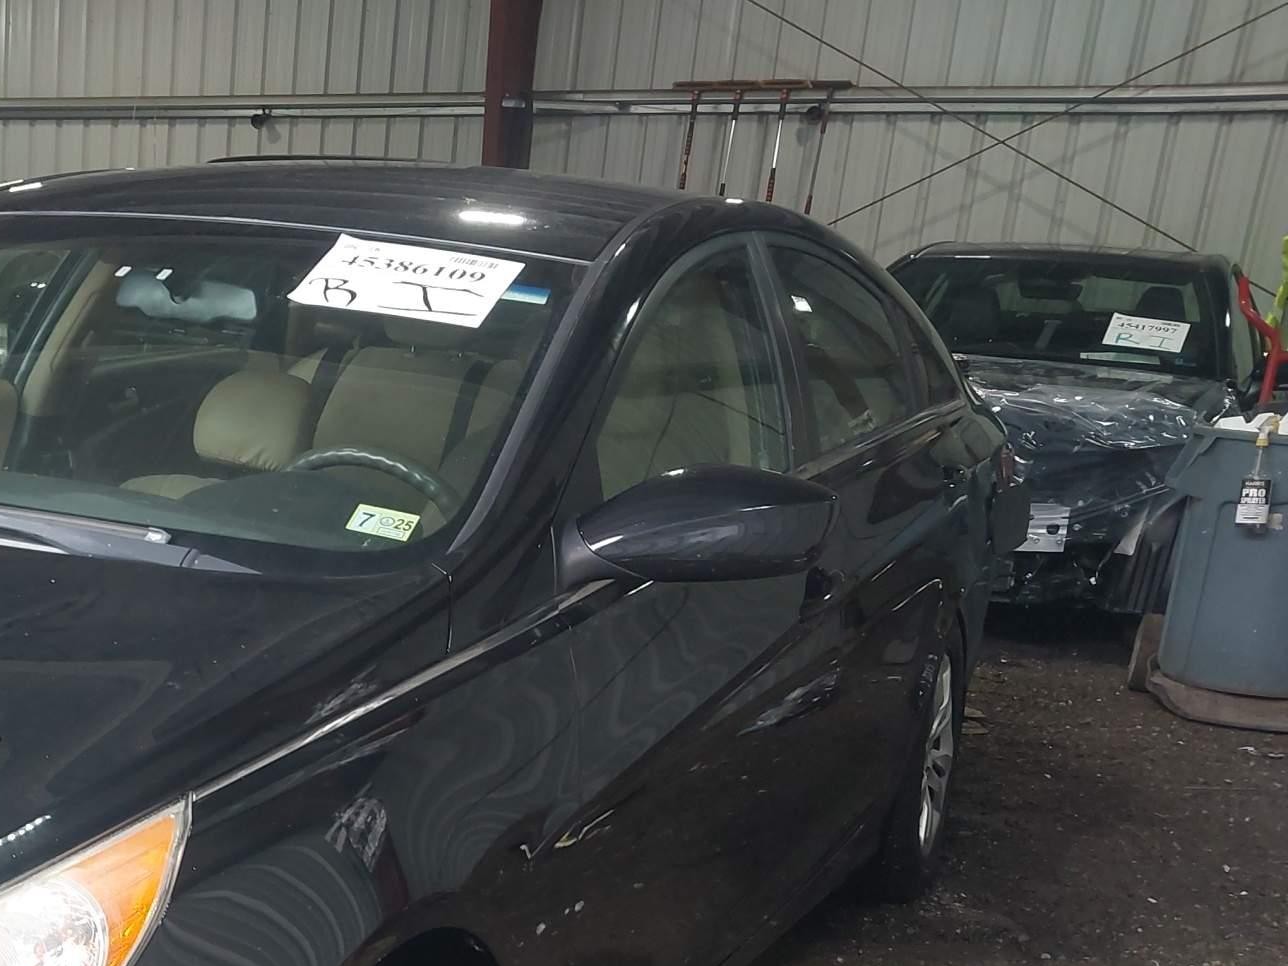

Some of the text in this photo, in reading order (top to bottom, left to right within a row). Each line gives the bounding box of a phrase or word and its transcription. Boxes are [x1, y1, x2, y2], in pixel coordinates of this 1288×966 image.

[341, 255, 486, 282] 45386109
[1115, 332, 1140, 345] R
[1242, 488, 1266, 497] PRO
[359, 511, 414, 531] 7 25
